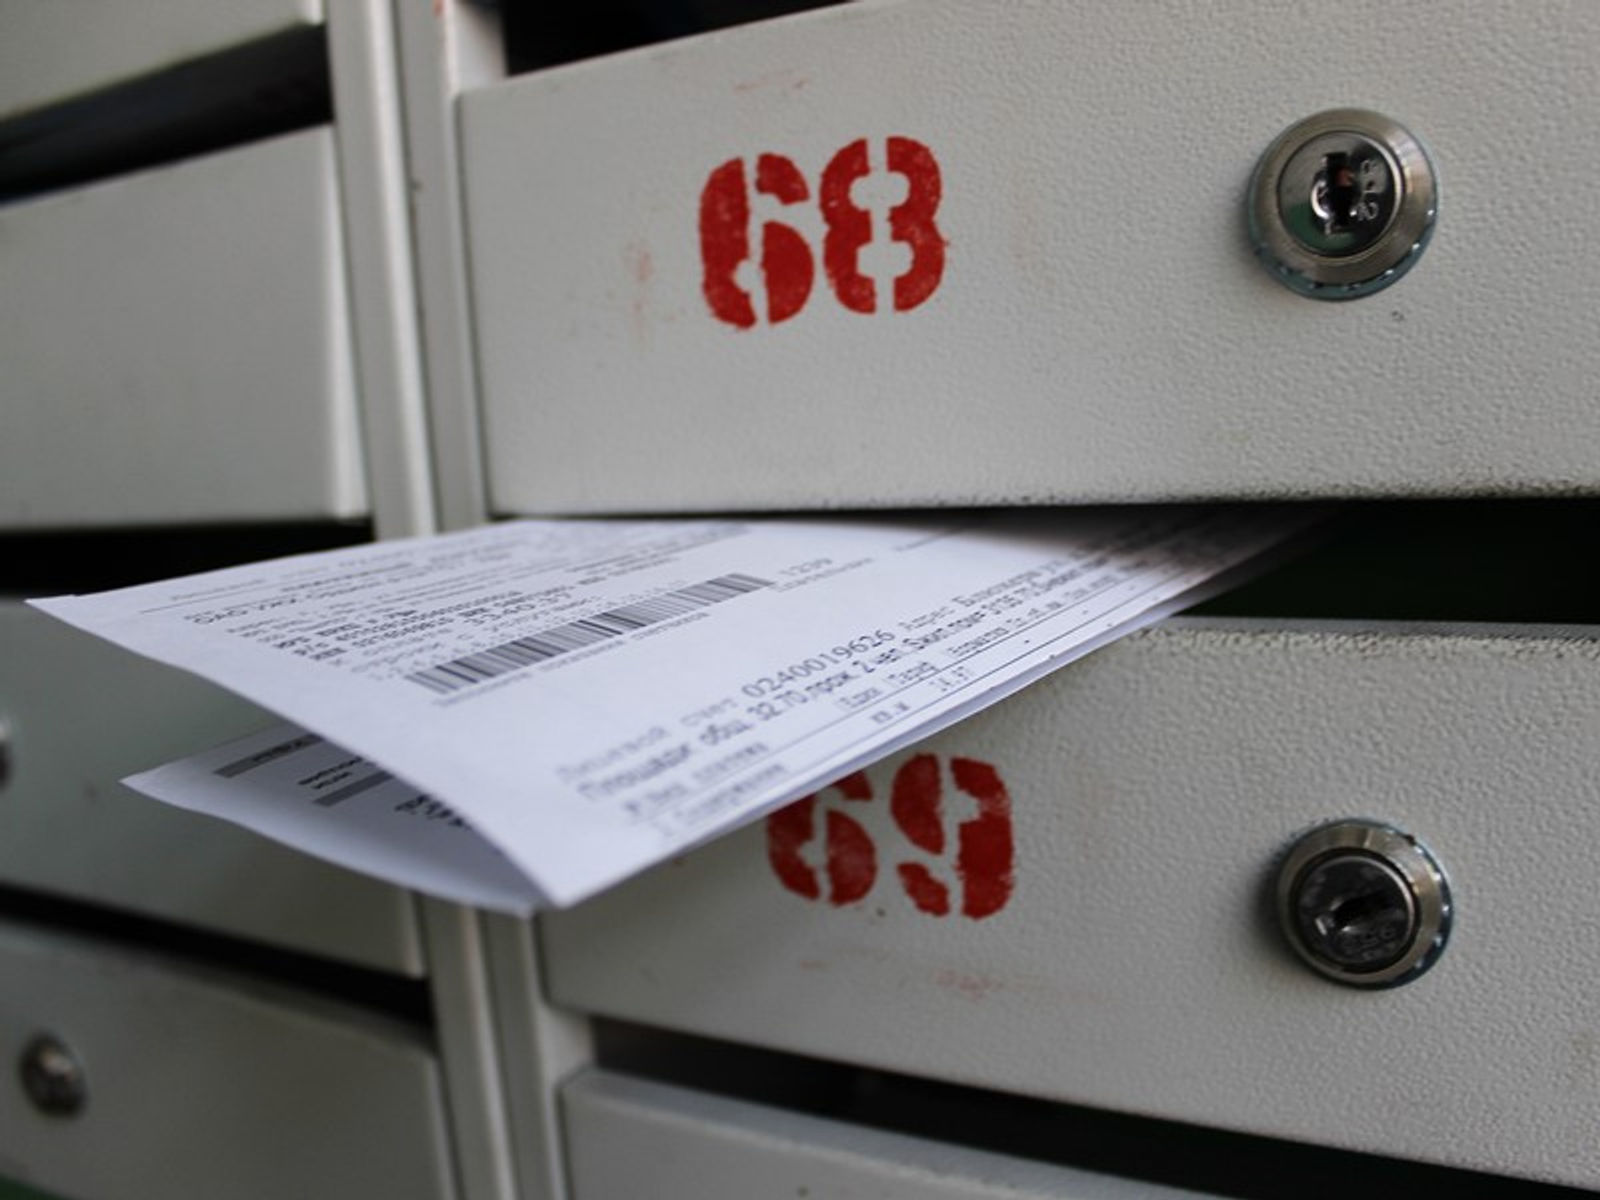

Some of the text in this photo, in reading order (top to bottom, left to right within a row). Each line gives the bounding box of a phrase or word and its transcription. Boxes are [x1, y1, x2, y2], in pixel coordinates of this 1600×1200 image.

[698, 135, 949, 331] 68
[741, 628, 896, 699] 0240019626
[766, 752, 1016, 921] 69
